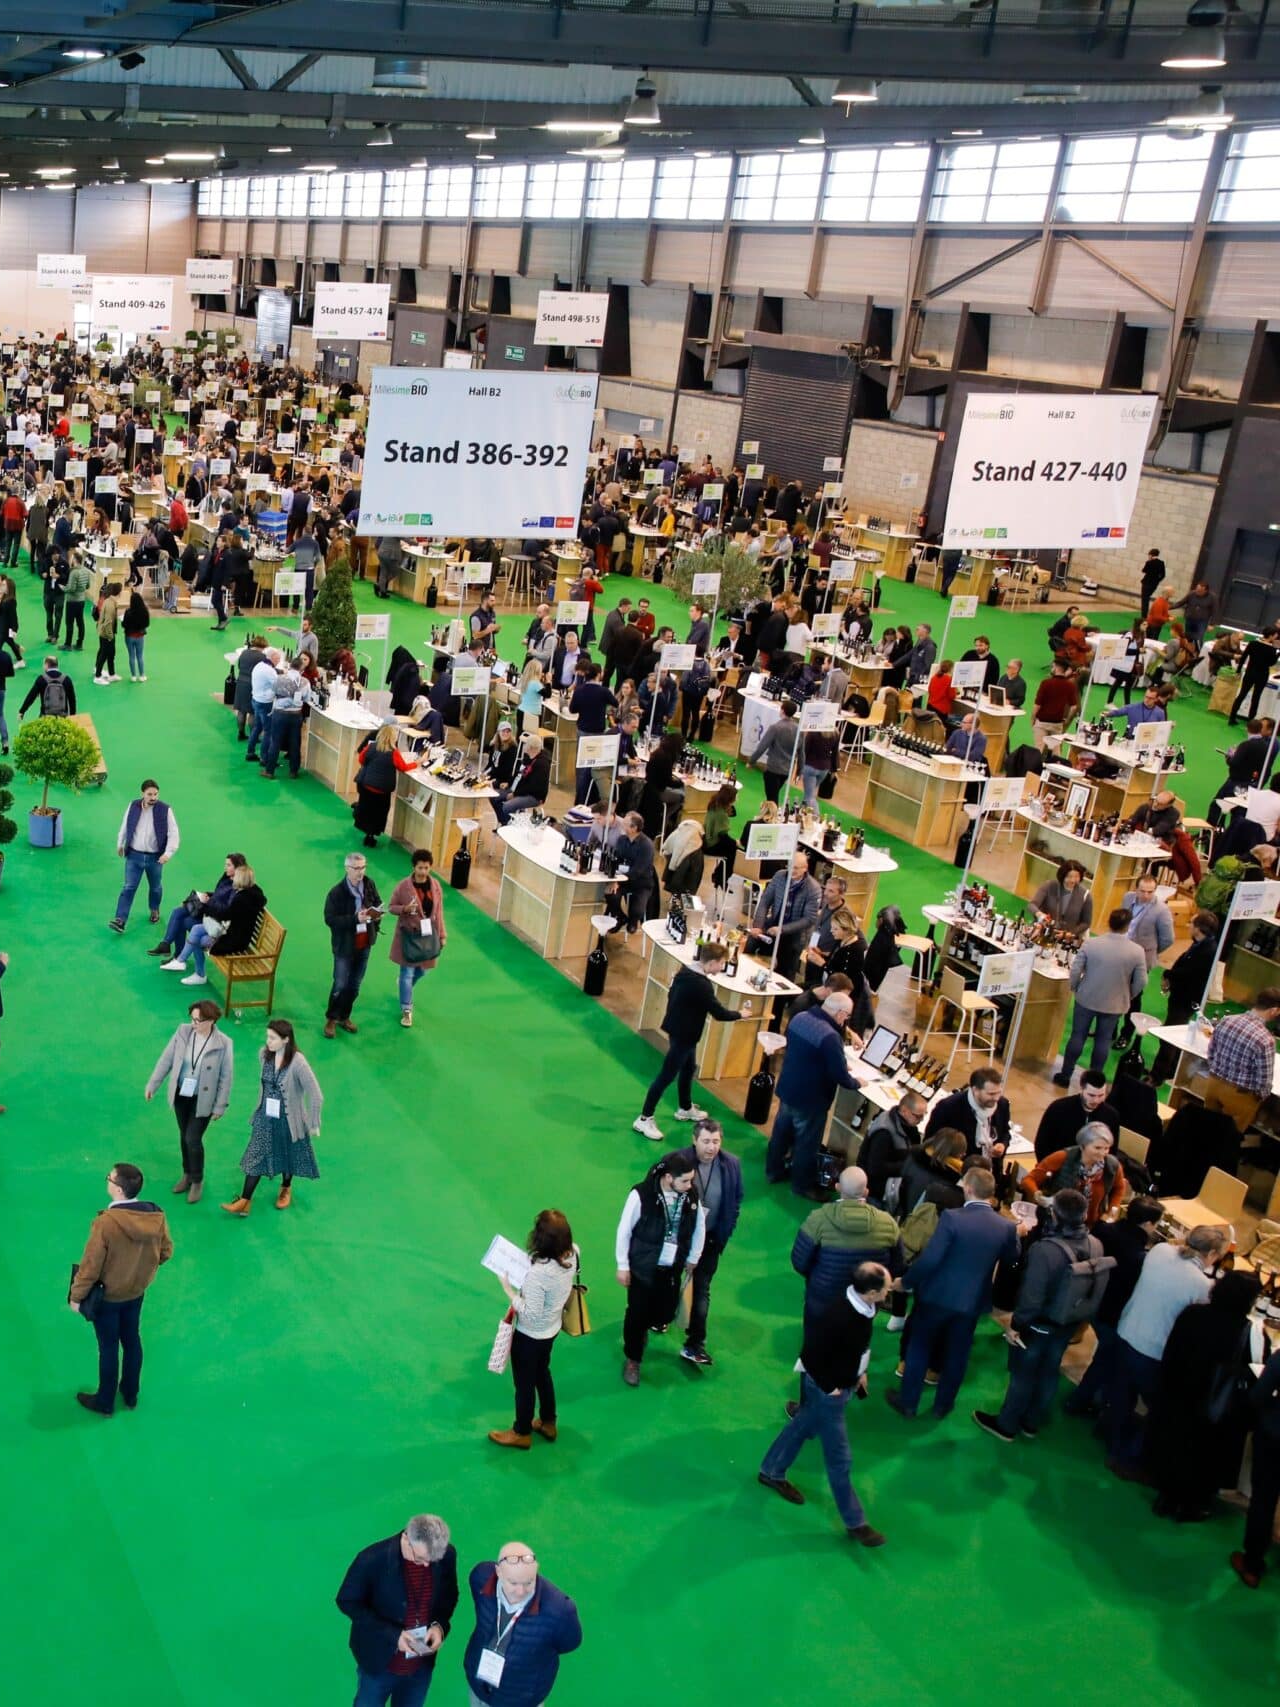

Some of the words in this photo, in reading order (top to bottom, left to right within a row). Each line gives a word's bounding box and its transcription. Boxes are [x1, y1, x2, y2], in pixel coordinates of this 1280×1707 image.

[99, 298, 126, 309] Stand
[128, 300, 166, 310] 409-426
[320, 306, 346, 315] Stand
[347, 306, 383, 316] 457-474
[542, 313, 566, 322] Stand
[567, 314, 600, 324] 498-515
[468, 386, 487, 397] Hall
[489, 388, 501, 397] B2
[1047, 410, 1064, 420] Hall
[1065, 411, 1076, 420] B2
[384, 440, 460, 464] Stand
[466, 442, 569, 467] 386-392
[972, 460, 1036, 482] Stand
[1040, 462, 1127, 482] 427-440
